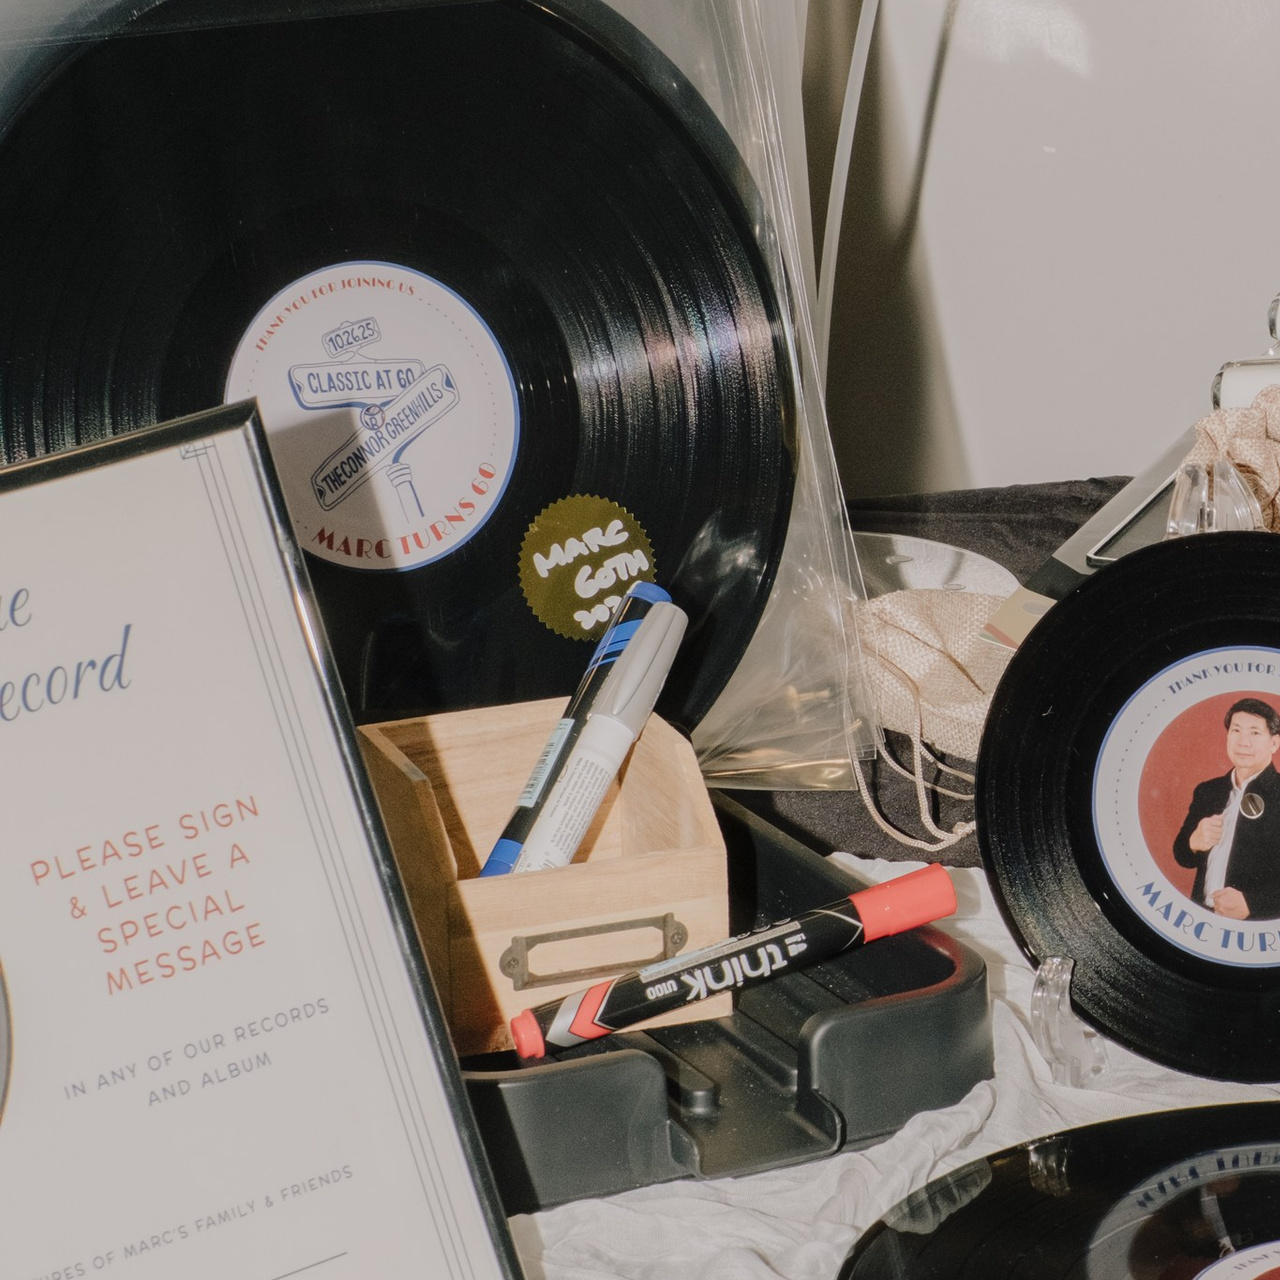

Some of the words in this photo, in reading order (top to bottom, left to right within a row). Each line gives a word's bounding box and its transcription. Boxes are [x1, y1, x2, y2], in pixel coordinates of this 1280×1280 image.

[255, 315, 287, 352] THANK
[285, 293, 311, 315] YOU
[311, 282, 339, 300] FOR
[341, 277, 396, 290] JOINING
[398, 281, 416, 296] US
[307, 370, 372, 394] CLASSIC
[376, 369, 393, 390] AT
[385, 381, 444, 440] GREENHILLS
[311, 525, 391, 560] MARC
[395, 496, 476, 556] TURNS
[471, 461, 497, 496] 60
[532, 519, 630, 578] MARC
[1165, 666, 1215, 696] THANK
[1212, 661, 1246, 677] YOU
[1247, 662, 1277, 677] FOR
[30, 824, 165, 886] PLEASE
[178, 795, 259, 840] SIGN
[69, 896, 88, 920] &
[101, 852, 213, 909] LEAVE
[230, 843, 250, 870] A
[1135, 880, 1216, 944] MARC
[97, 888, 246, 954] SPECIAL
[106, 922, 266, 996] MESSAGE
[645, 979, 679, 1000] U100
[681, 943, 789, 1002] think
[63, 1079, 87, 1101] IN
[96, 1062, 138, 1091] ANY
[147, 1049, 175, 1072] OF
[183, 1033, 226, 1060] OUR
[233, 997, 330, 1042] RECORDS
[147, 1078, 192, 1108] AND
[201, 1050, 273, 1089] ALBUM
[92, 1251, 116, 1271] OF
[123, 1224, 190, 1259] MARC'S
[194, 1199, 257, 1234] FAMILY
[264, 1195, 275, 1209] &
[279, 1164, 354, 1202] FRIENDS
[1233, 1253, 1274, 1271] THANK
